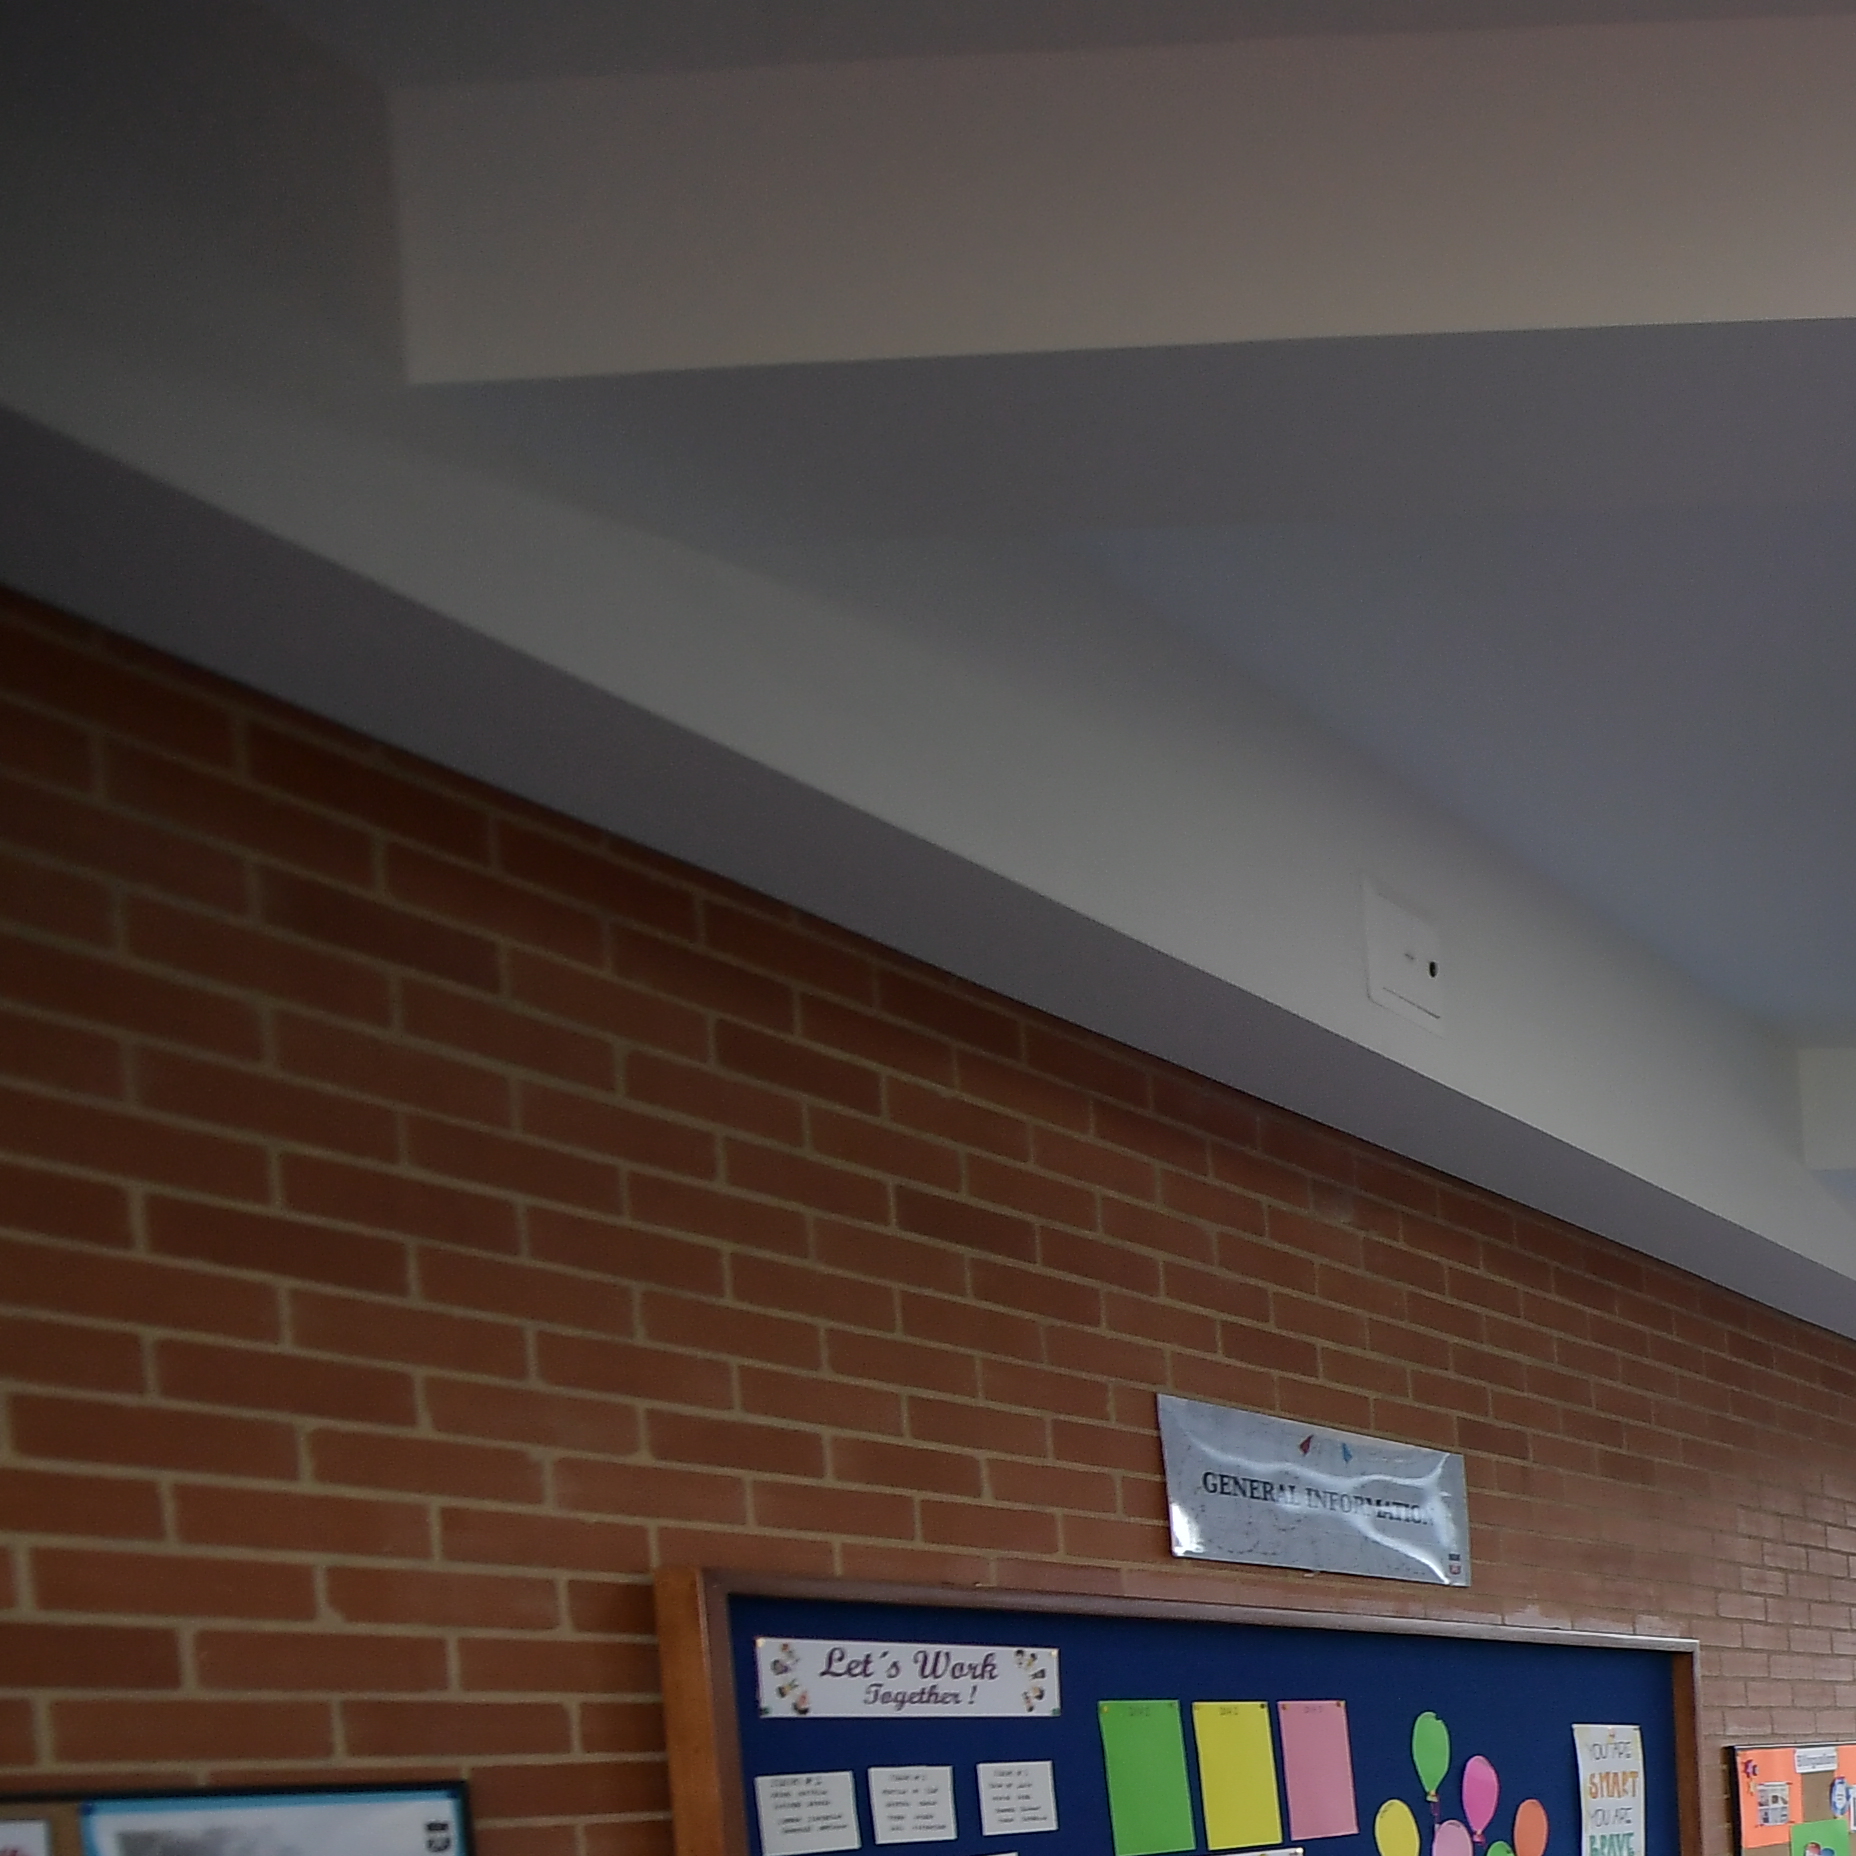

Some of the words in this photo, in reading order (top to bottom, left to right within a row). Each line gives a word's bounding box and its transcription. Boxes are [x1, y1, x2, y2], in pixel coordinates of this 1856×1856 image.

[1202, 1471, 1299, 1505] GENERAL
[913, 1650, 999, 1681] Work
[864, 1683, 962, 1712] Together
[1588, 1771, 1638, 1800] SMART
